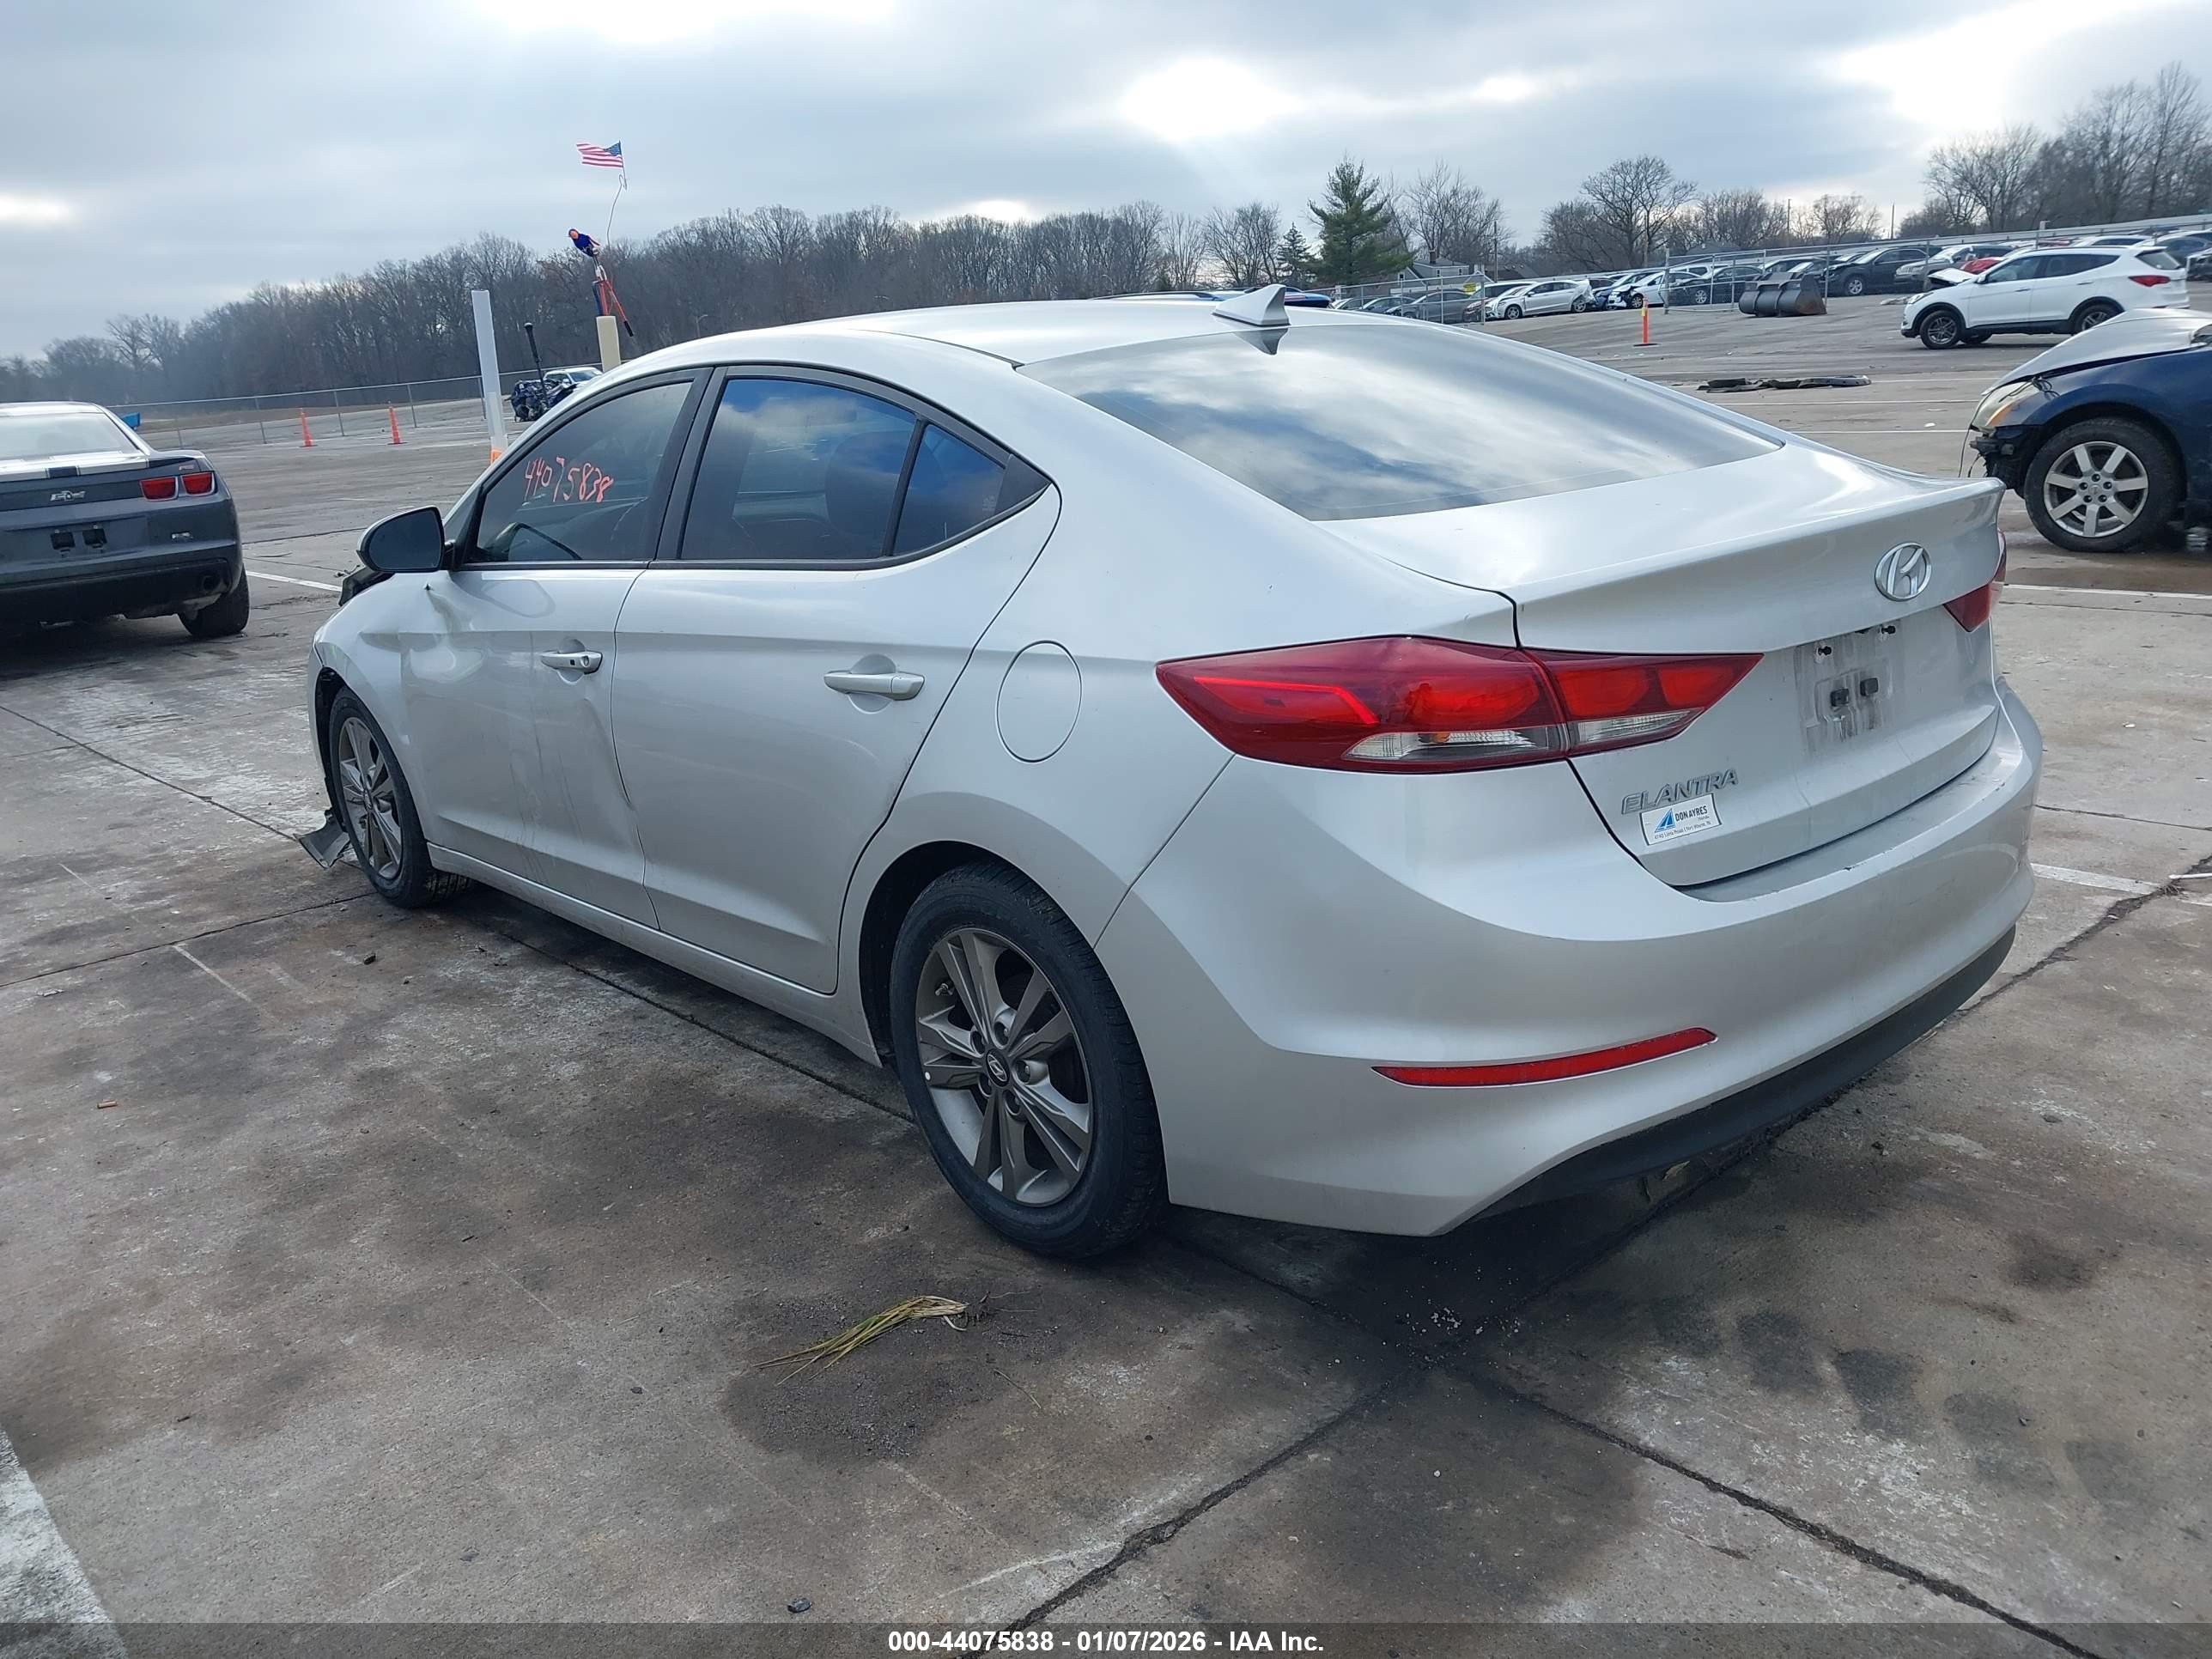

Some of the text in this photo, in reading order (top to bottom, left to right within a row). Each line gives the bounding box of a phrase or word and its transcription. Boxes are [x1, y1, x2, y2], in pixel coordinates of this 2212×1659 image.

[524, 456, 614, 503] 44075838
[1621, 769, 1738, 814] ELANTRA
[1689, 805, 1708, 817] AYRES
